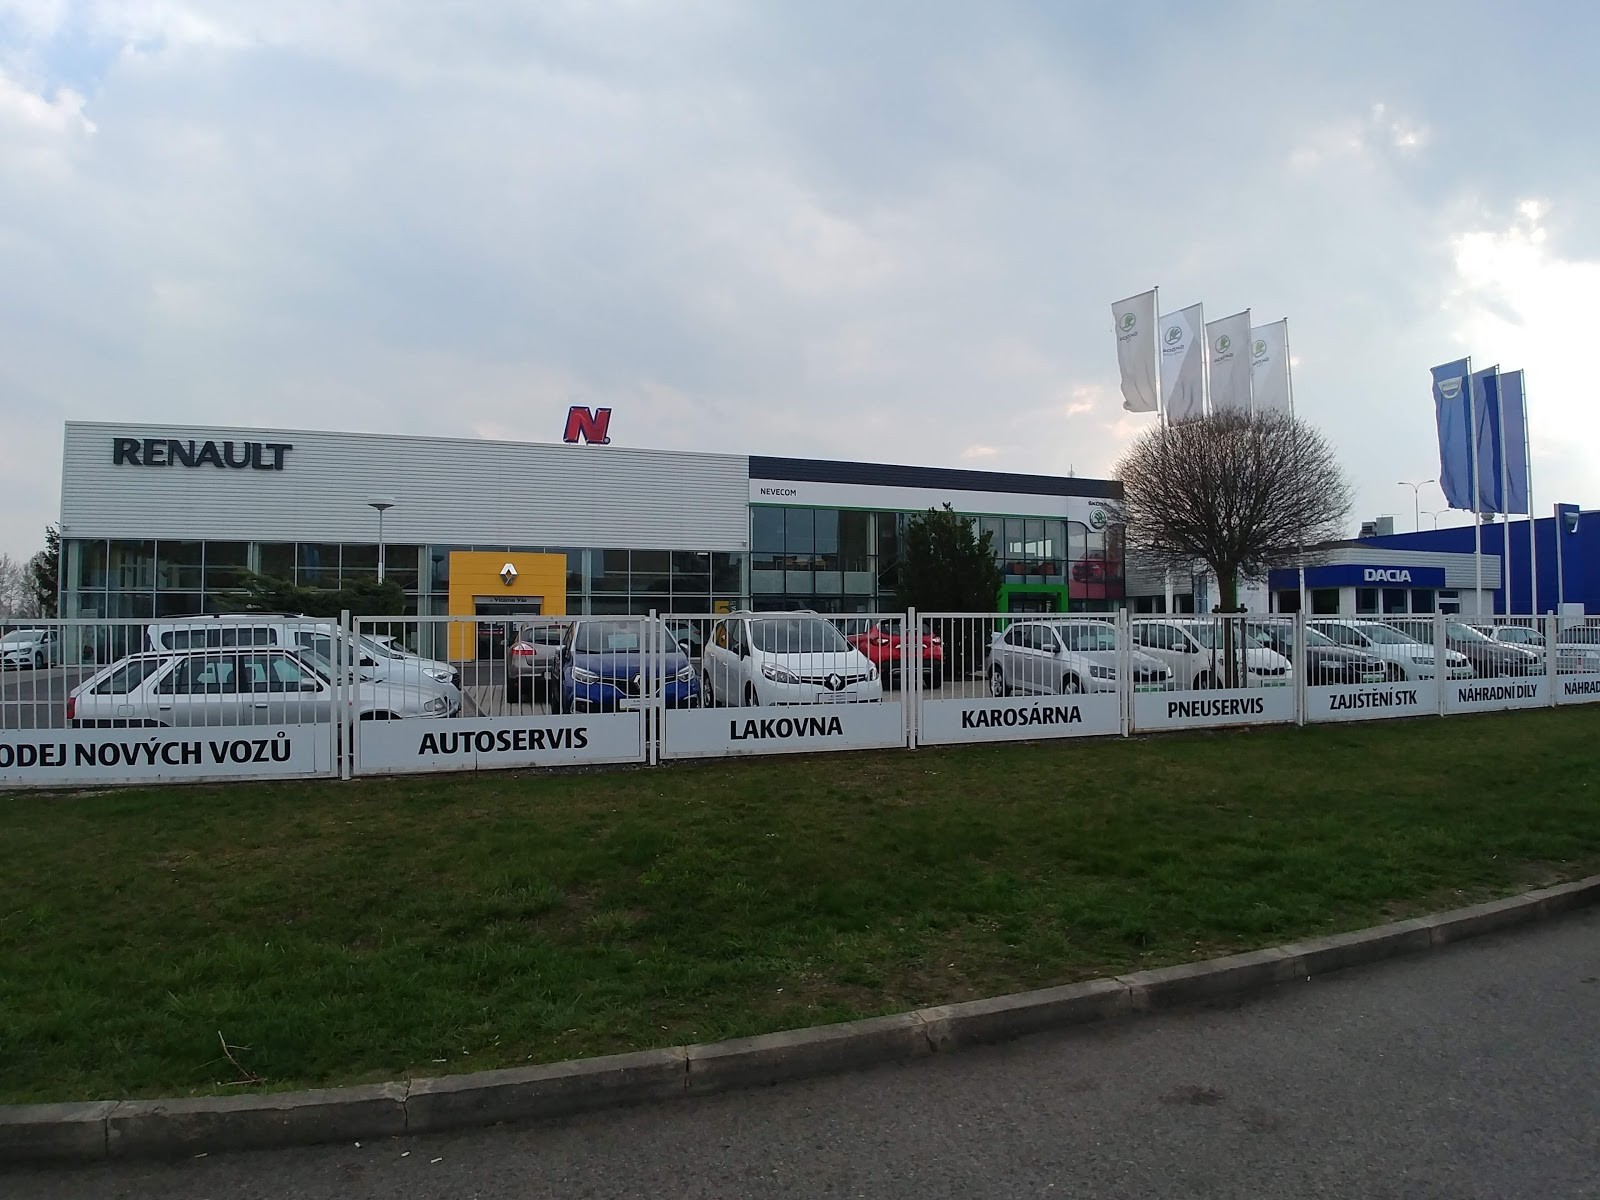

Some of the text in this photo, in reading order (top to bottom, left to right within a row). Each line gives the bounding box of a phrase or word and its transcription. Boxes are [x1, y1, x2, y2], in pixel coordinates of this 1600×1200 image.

[113, 438, 292, 470] RENAULT
[760, 488, 797, 496] NEVECOM
[1363, 568, 1412, 582] DACIA
[1329, 687, 1418, 710] ZAJIŠTĚNÍ STK
[1458, 682, 1538, 703] NÁHRADNÍ DÍLY
[962, 702, 1082, 728] KAROSÁRNA
[1168, 697, 1264, 719] PNEUSERVIS
[730, 716, 843, 740] LAKOVNA
[75, 737, 202, 766] NOVÝCH
[209, 732, 291, 764] VOZŮ
[418, 728, 588, 755] AUTOSERVIS
